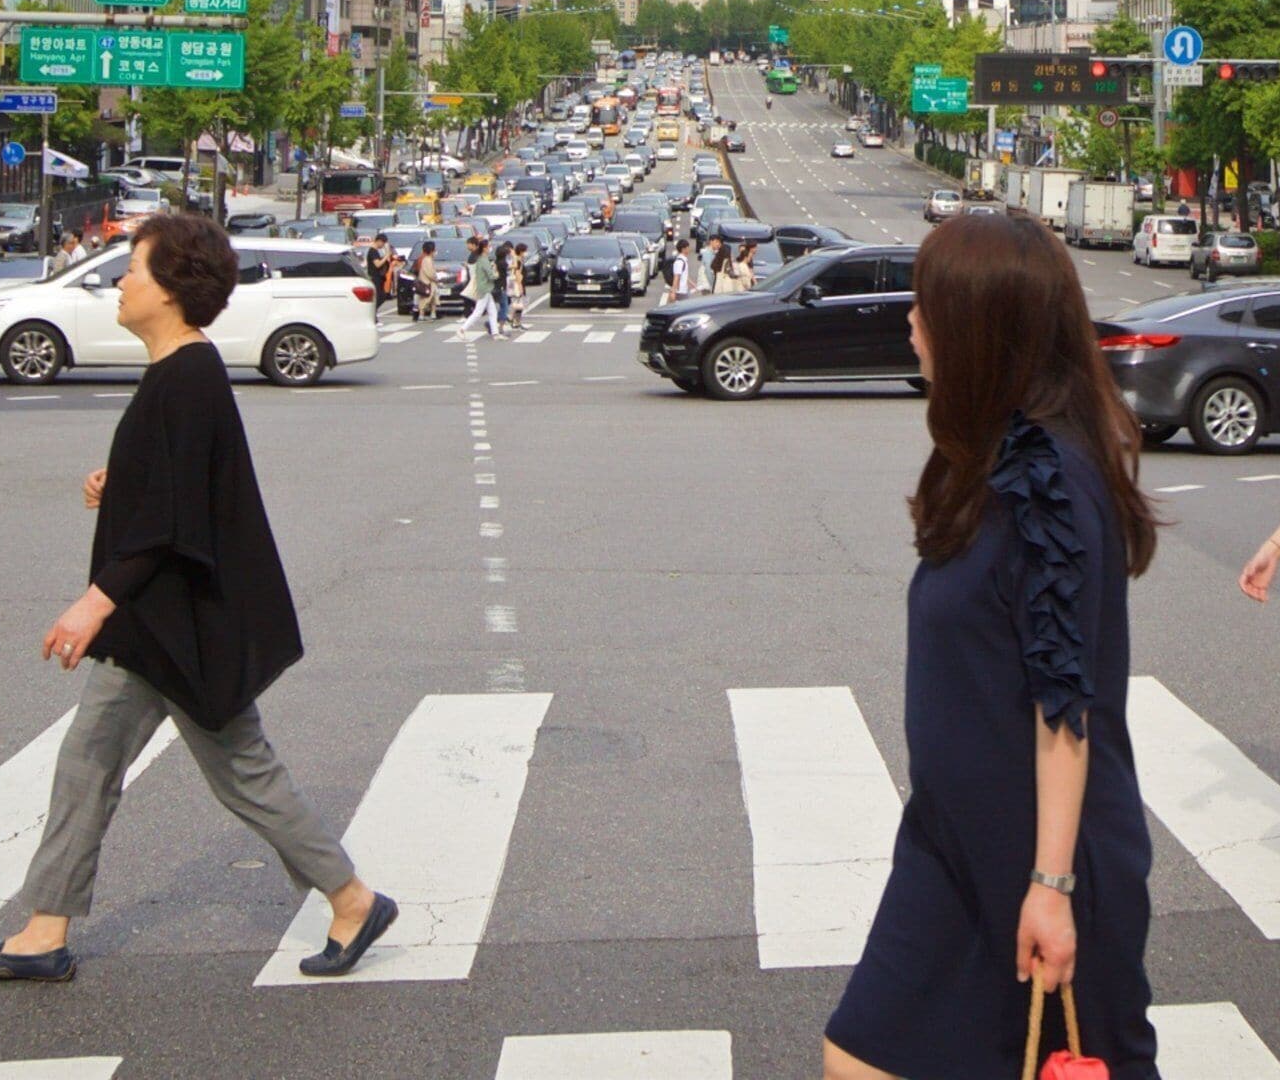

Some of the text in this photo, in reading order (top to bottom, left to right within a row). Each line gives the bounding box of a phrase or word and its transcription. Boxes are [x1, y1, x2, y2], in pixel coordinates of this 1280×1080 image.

[30, 37, 87, 51] 한양아파트
[101, 37, 113, 47] 47
[118, 36, 164, 50] 영동대교
[180, 42, 233, 57] 청담공원
[30, 52, 86, 64] Hanyang Apt
[118, 59, 160, 73] 코엑스
[1033, 63, 1078, 77] 강변북로
